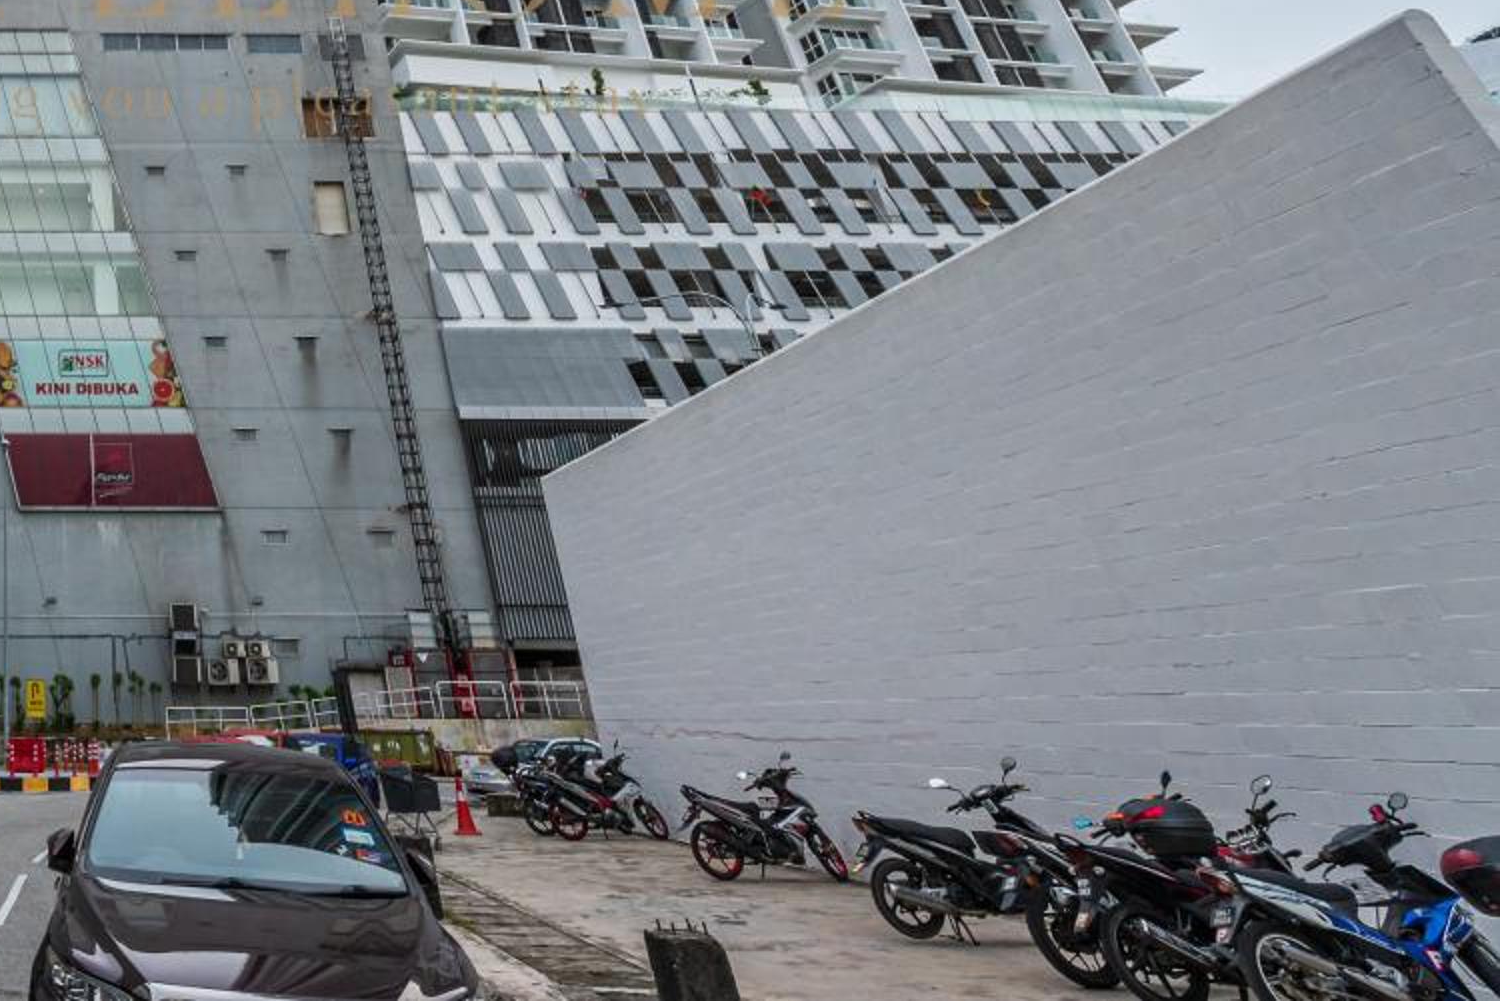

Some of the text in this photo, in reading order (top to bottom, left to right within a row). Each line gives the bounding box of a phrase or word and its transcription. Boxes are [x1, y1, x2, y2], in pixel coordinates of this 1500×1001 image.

[74, 355, 105, 368] NSK
[35, 382, 139, 395] KINI DIBUKA
